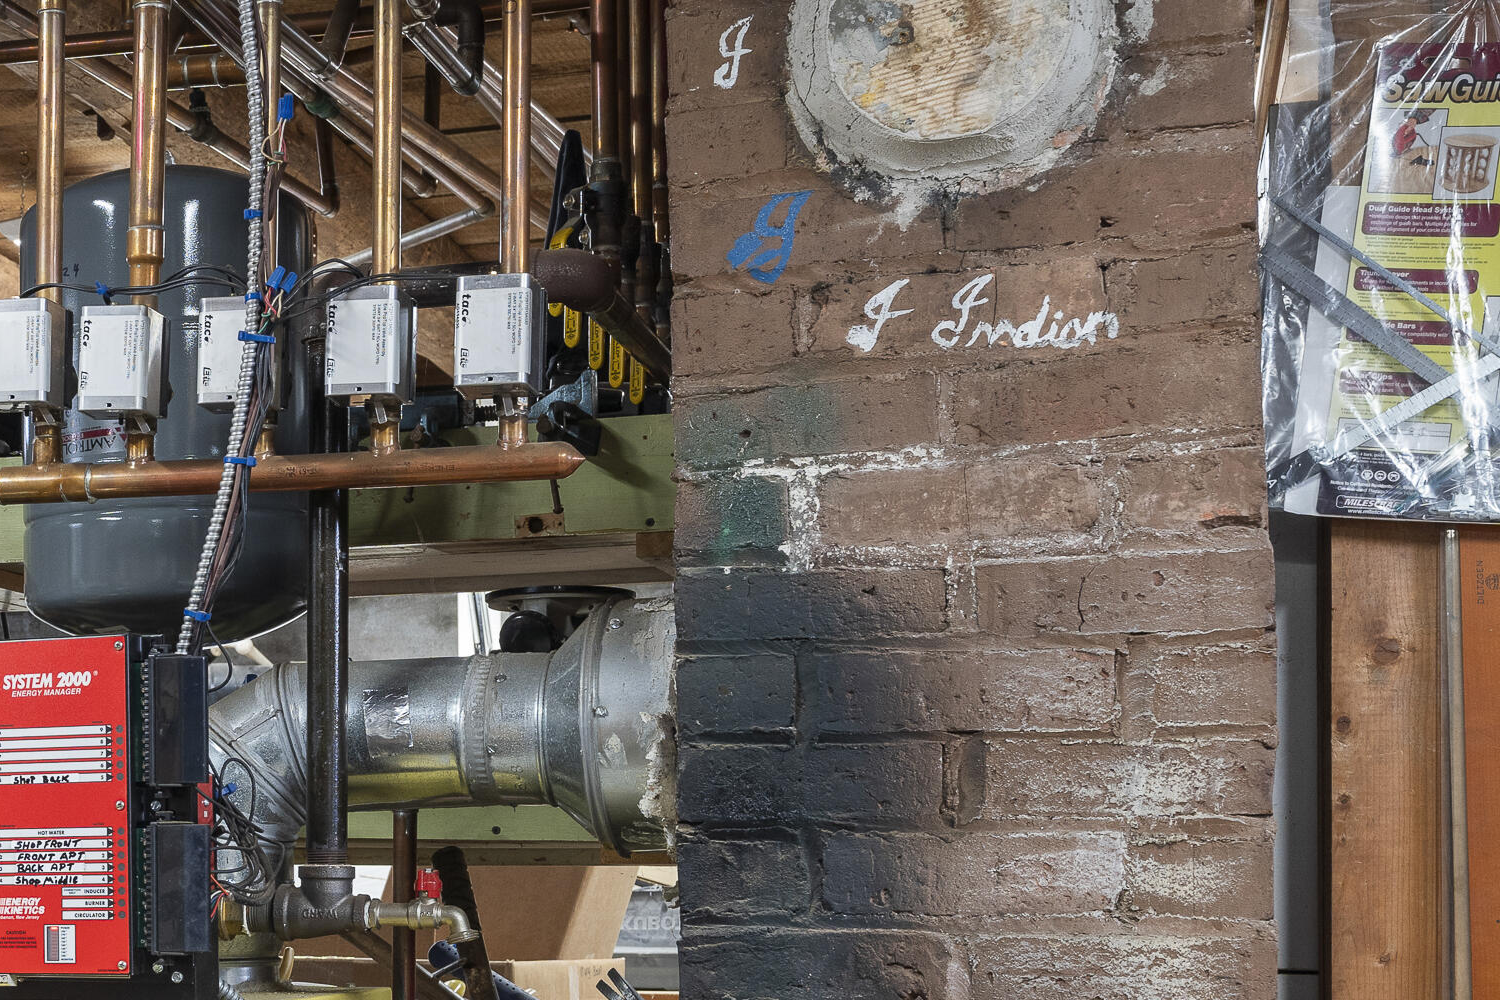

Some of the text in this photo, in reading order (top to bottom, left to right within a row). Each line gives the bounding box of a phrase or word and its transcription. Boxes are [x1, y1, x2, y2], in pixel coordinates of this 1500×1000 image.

[1434, 206, 1463, 214] Systm
[1344, 499, 1399, 508] MILESCRA
[3, 673, 52, 690] SYSTEM
[11, 688, 81, 698] ENERGY MANAGER
[18, 853, 55, 861] FRONT
[59, 852, 85, 860] APT
[17, 864, 43, 872] BACK
[51, 863, 74, 871] APT
[5, 897, 41, 906] ENERGY
[4, 906, 45, 915] KINETICS
